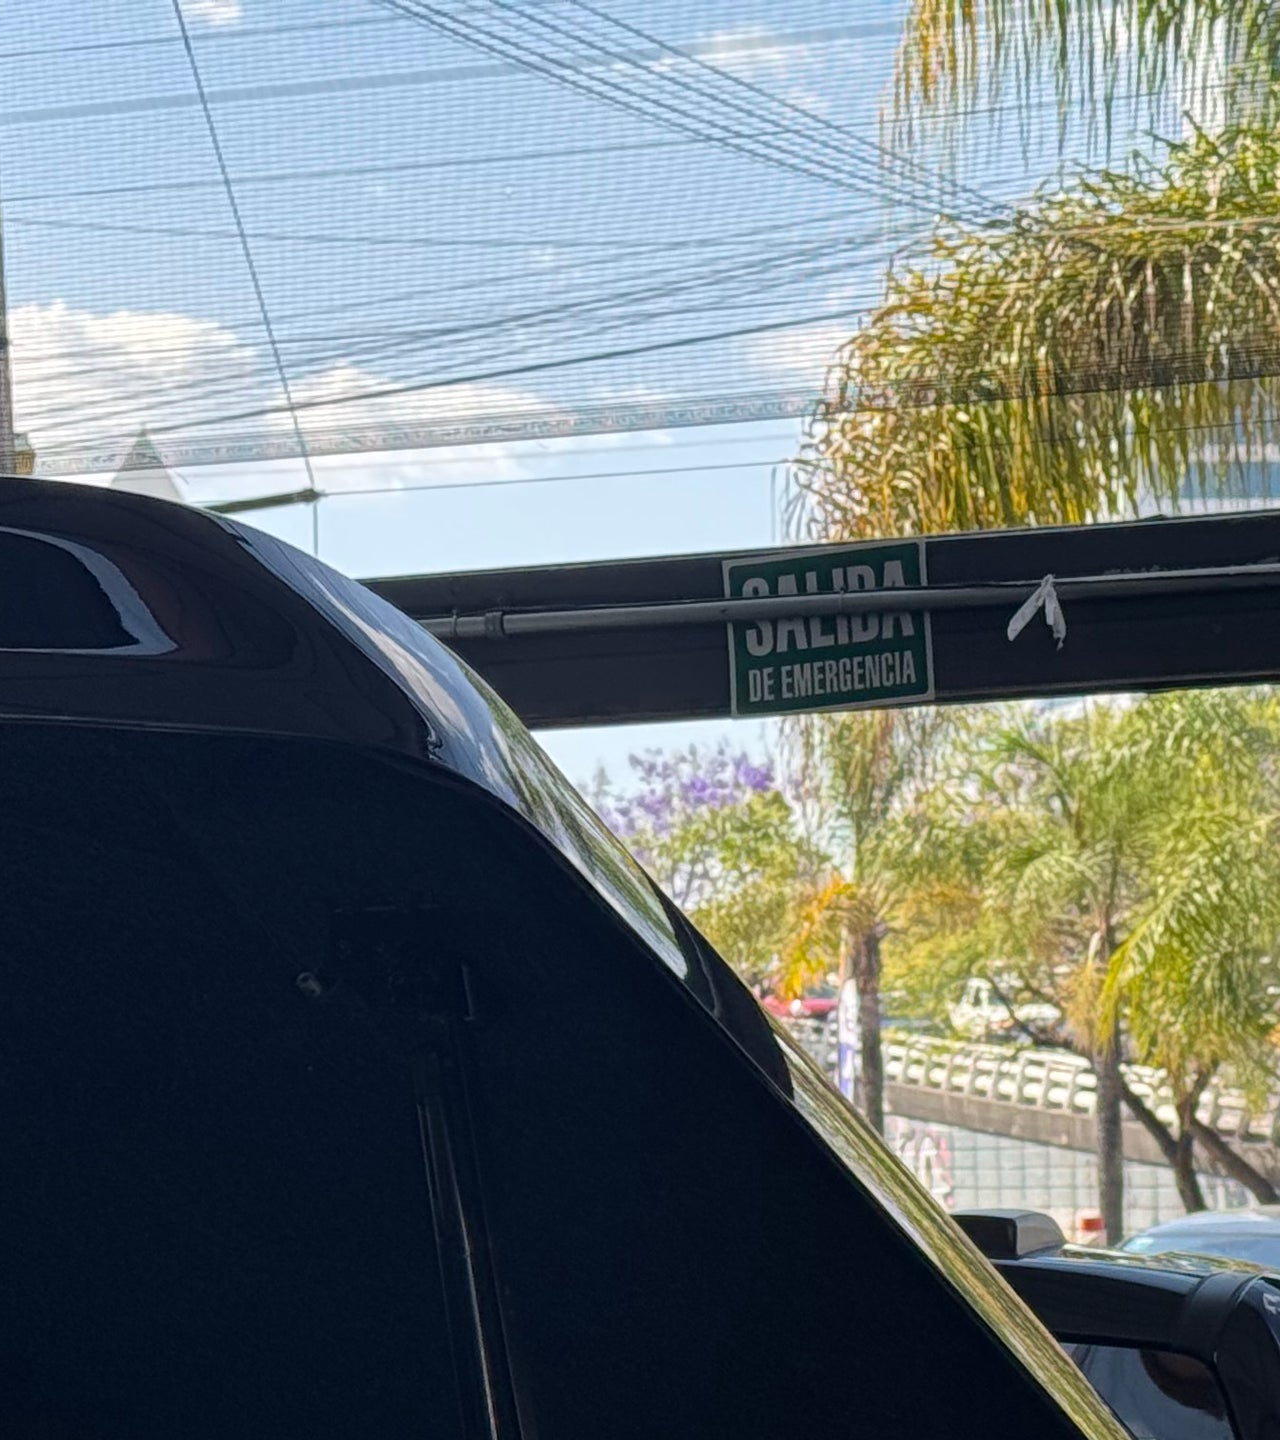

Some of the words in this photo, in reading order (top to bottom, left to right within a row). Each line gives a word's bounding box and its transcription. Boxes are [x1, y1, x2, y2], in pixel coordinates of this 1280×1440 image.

[741, 559, 915, 657] SALIDA
[748, 667, 776, 703] DE
[781, 650, 917, 699] EMERGENCIA
